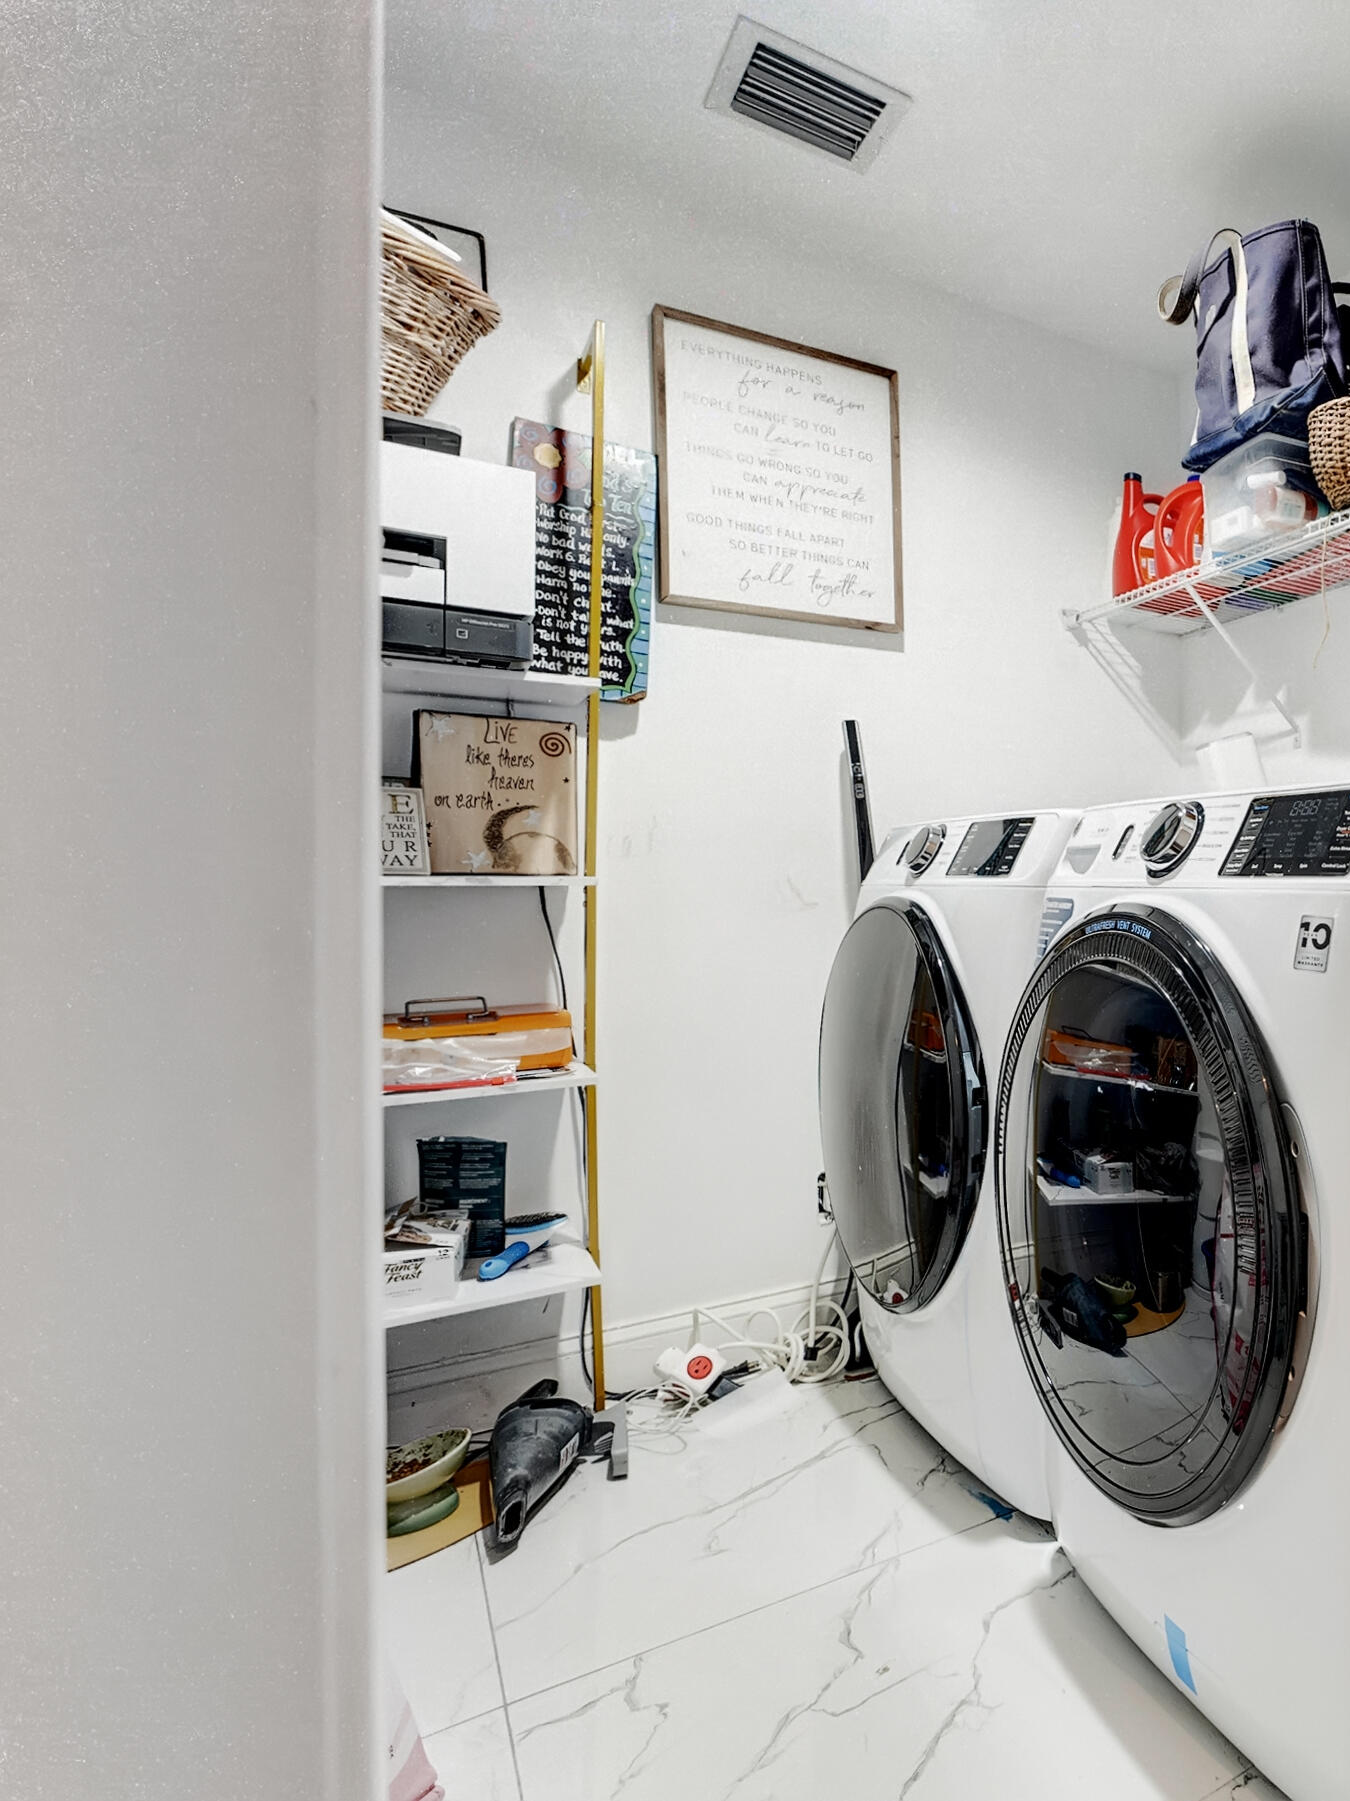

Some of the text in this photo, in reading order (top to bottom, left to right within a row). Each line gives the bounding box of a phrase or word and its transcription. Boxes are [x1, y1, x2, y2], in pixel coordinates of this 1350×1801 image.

[680, 339, 823, 386] EVERYTHING HAPPENS
[737, 369, 865, 416] for a reason
[682, 391, 837, 437] PEOPLE CHANGE SO YOU
[733, 423, 874, 463] CAN learn TO LET GO
[685, 441, 849, 486] THINGS GO WRONG SO YOU
[742, 472, 868, 506] CAN appreciate
[711, 485, 875, 525] THEM WHEN THEY'RE RIGHT
[559, 508, 588, 526] God
[603, 531, 630, 548] only.
[685, 512, 845, 549] GOOD THINGS FALL APART
[551, 534, 576, 551] bad
[728, 539, 870, 571] SO BETTER THINGS CAN
[536, 573, 568, 589] Harm
[537, 560, 566, 578] Obey
[569, 568, 591, 581] you
[738, 561, 876, 607] fall together
[535, 589, 569, 606] Don't
[537, 605, 567, 620] Don't
[541, 615, 553, 627] is
[556, 619, 577, 632] not
[536, 628, 561, 642] Tell
[564, 633, 586, 648] the
[532, 643, 623, 668] Be happy ith
[567, 665, 589, 677] you
[599, 669, 624, 683] ave.
[465, 744, 535, 769] like theres
[487, 767, 535, 791] heaven
[433, 794, 452, 809] on
[1117, 919, 1131, 931] VENT
[1131, 923, 1152, 940] SYSTEM
[1300, 921, 1332, 950] 10
[384, 1261, 424, 1275] Fancy
[385, 1270, 422, 1284] Feast
